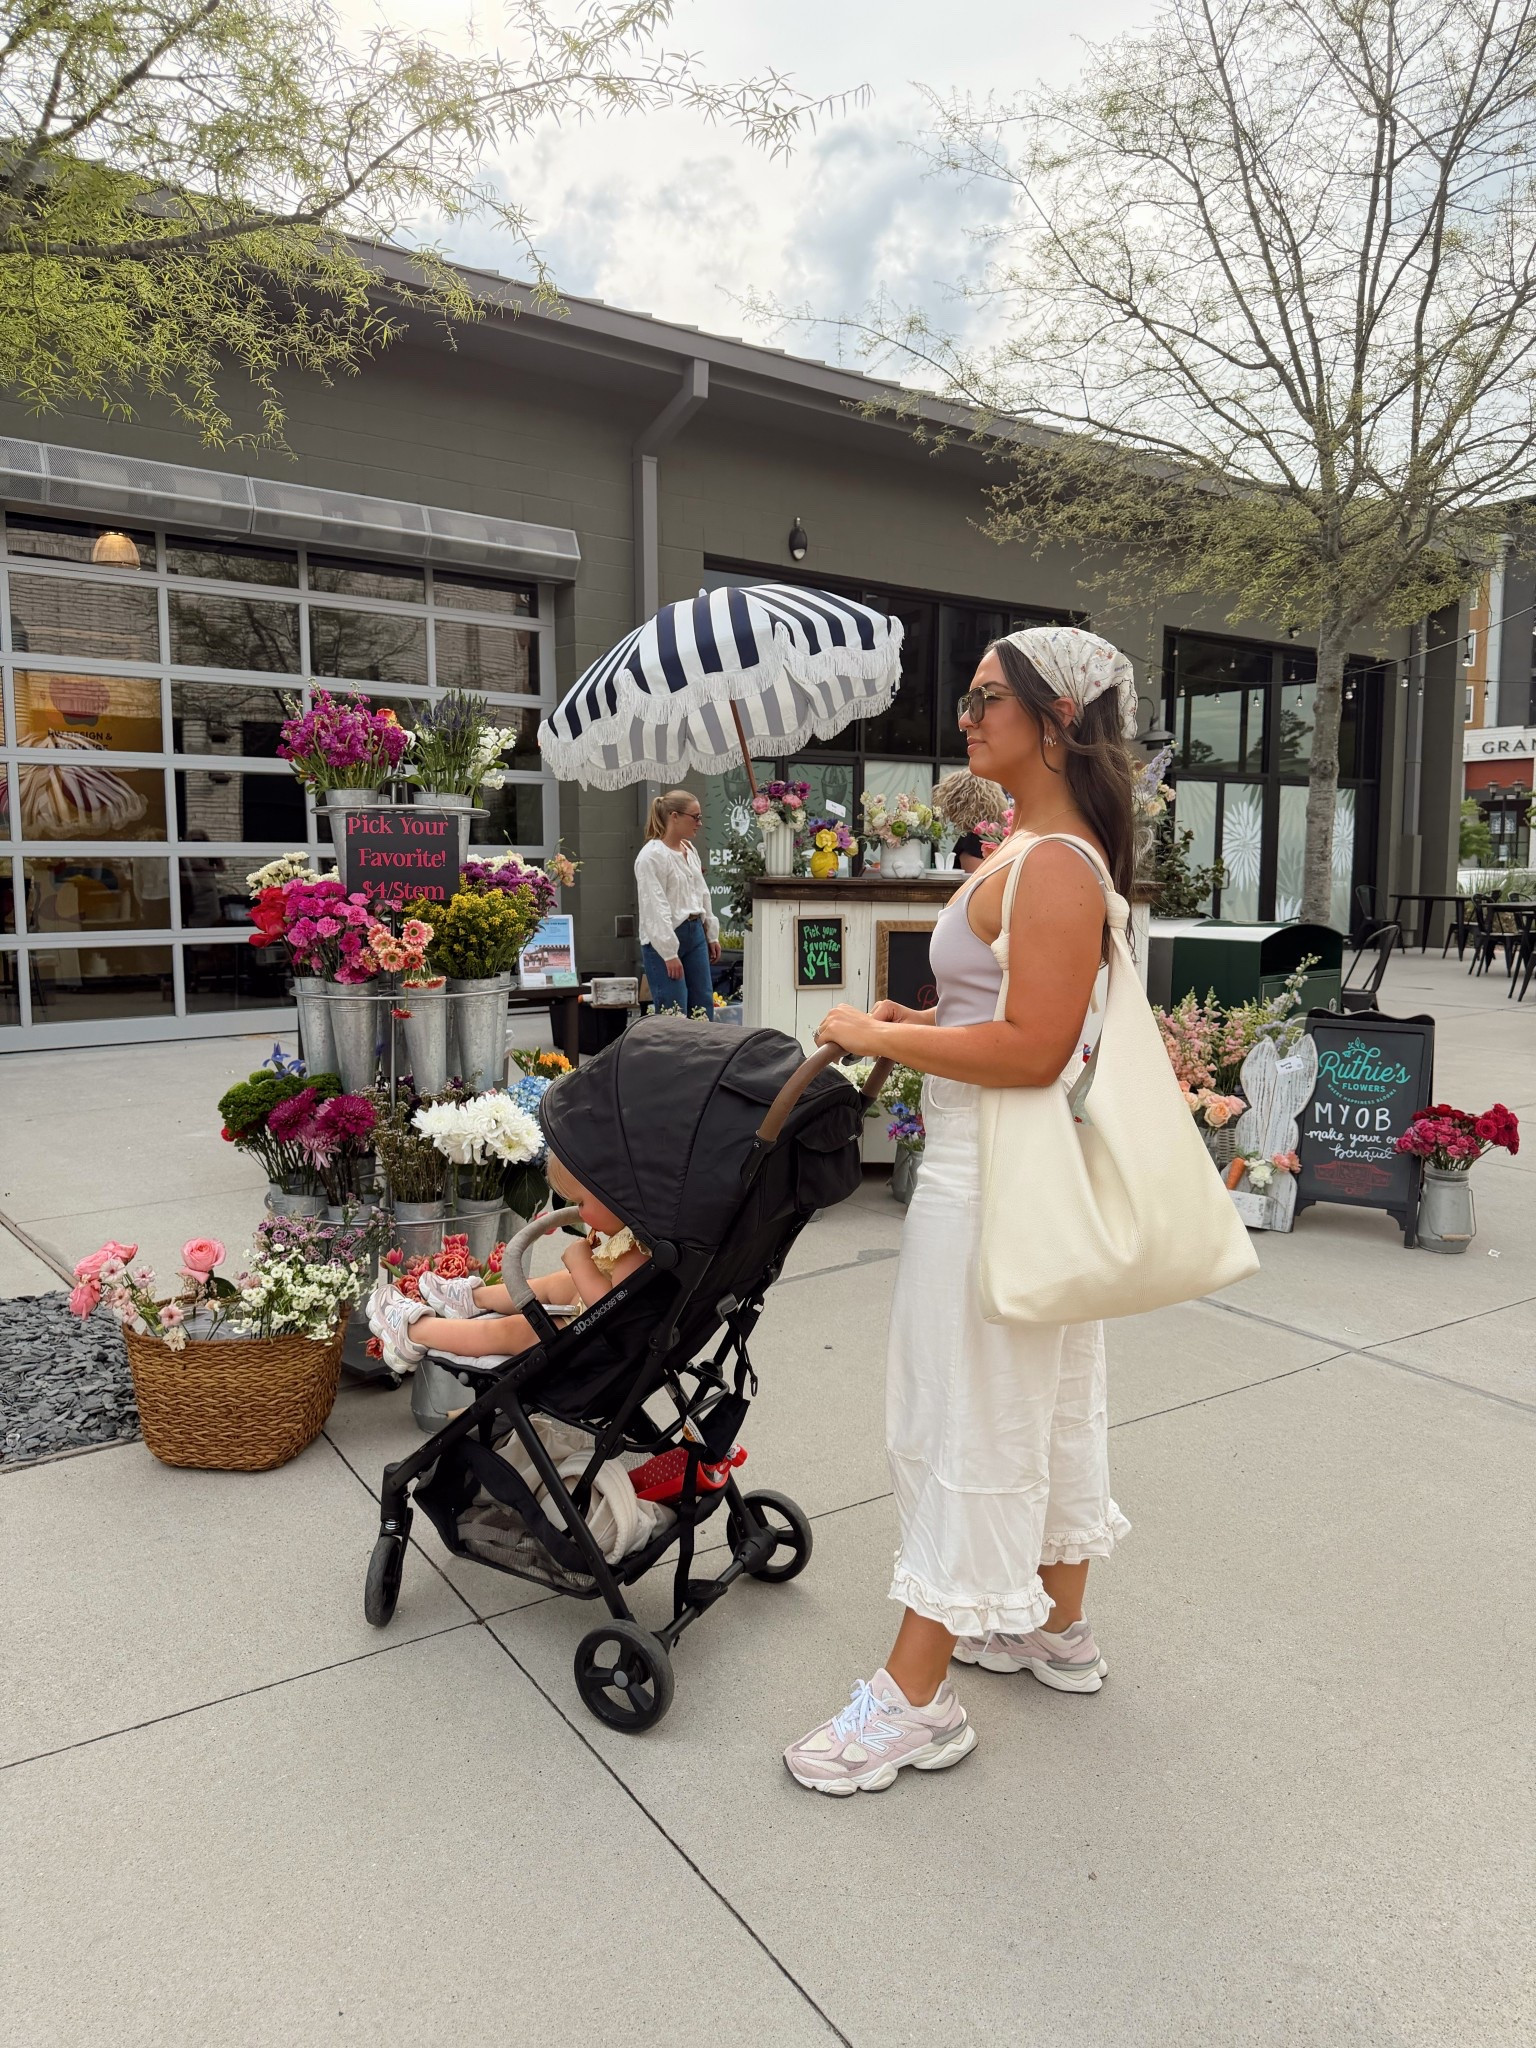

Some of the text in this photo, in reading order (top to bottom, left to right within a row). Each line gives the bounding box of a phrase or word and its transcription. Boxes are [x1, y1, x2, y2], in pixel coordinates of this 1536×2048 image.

[105, 732, 113, 741] &
[346, 815, 449, 836] Pick Your
[358, 848, 446, 868] Favorite!
[362, 880, 445, 900] $4/Stem
[710, 886, 732, 895] NOW
[803, 951, 829, 980] $4
[1316, 1047, 1411, 1085] Ruthie's
[1327, 1083, 1397, 1106] WHERE HAPPINESS BLOOMS
[1342, 1082, 1387, 1093] FLOWERS
[1314, 1101, 1392, 1132] MYOB
[1305, 1127, 1345, 1142] make
[1349, 1132, 1382, 1148] your
[1328, 1143, 1397, 1163] bouquet
